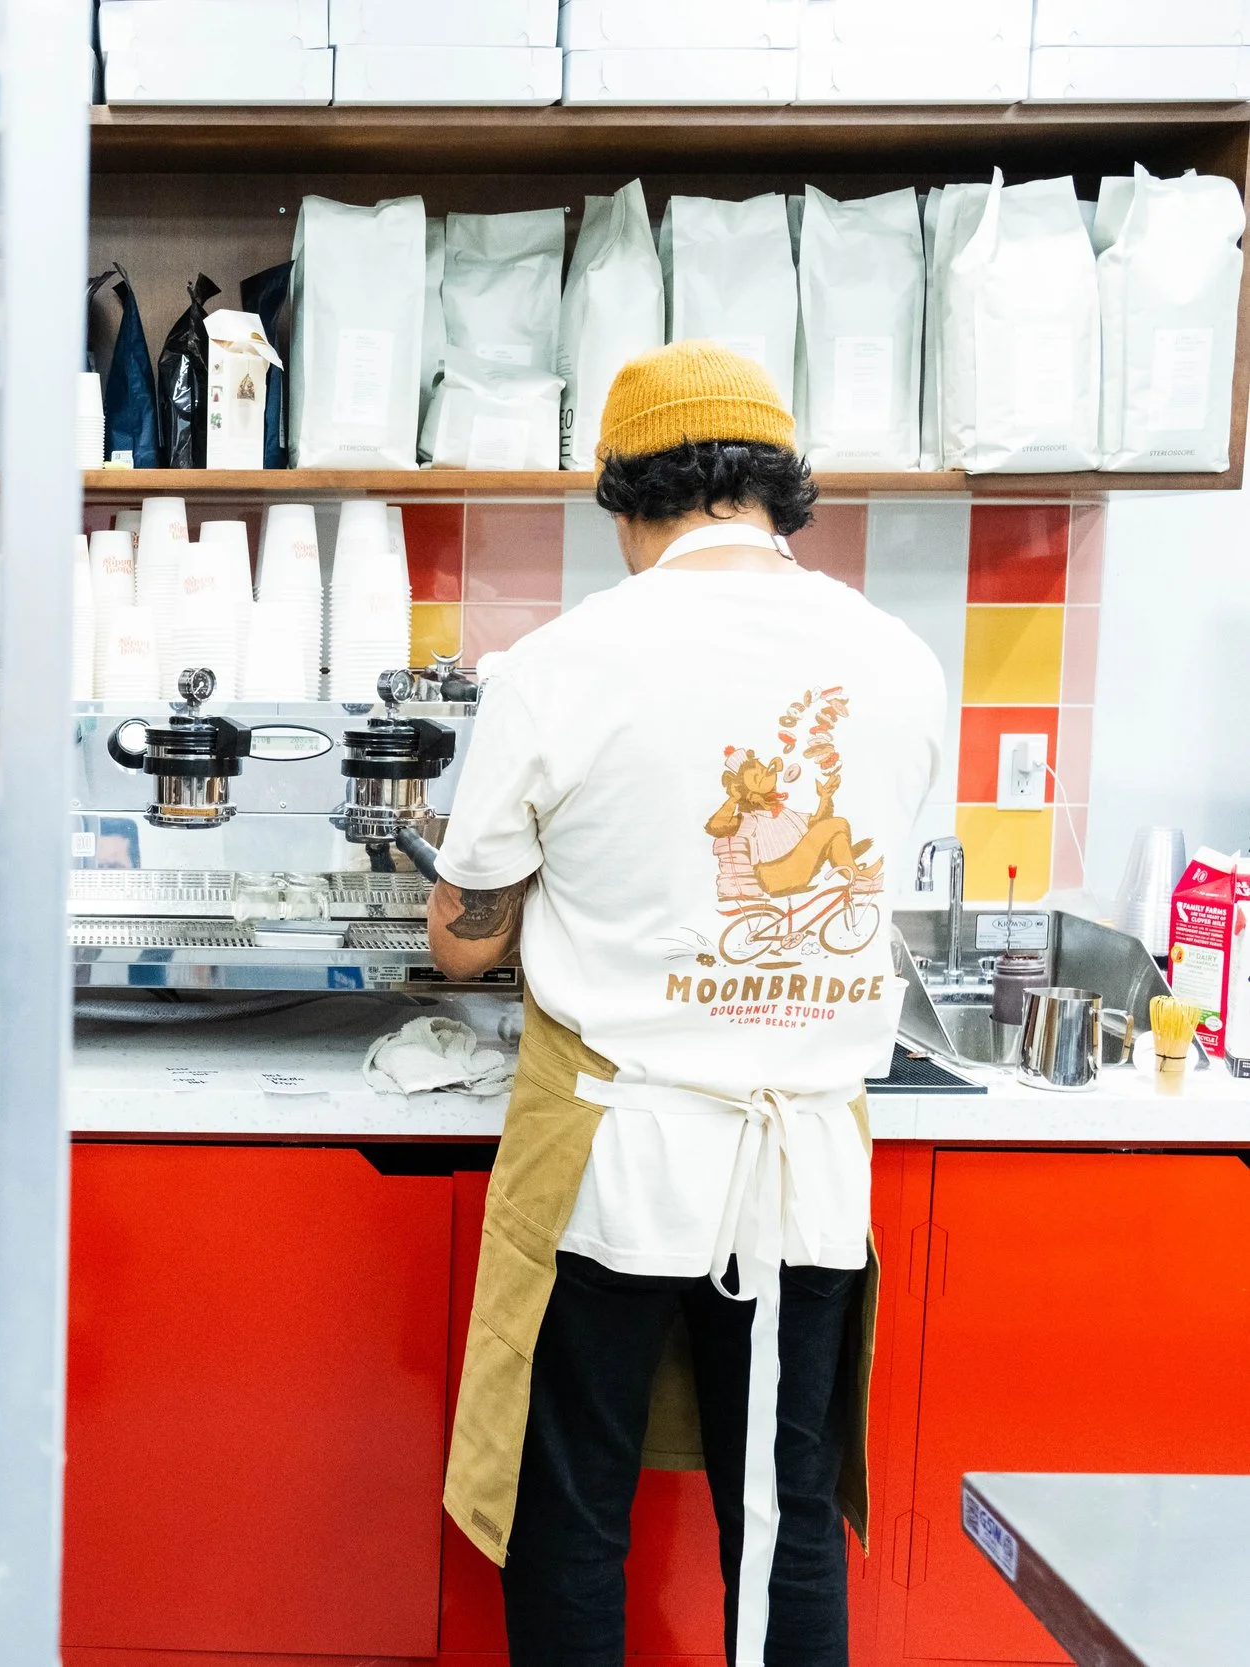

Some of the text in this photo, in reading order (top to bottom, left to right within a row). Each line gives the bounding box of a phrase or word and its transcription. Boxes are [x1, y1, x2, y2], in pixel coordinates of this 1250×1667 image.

[1149, 449, 1196, 457] STEREOSCOPE
[1183, 902, 1227, 916] FAMILY FARMS
[1191, 916, 1226, 927] CLOVER MILK
[1196, 953, 1217, 963] DAIRY
[666, 973, 885, 1004] MOONBRIDGE
[709, 1004, 836, 1020] DOUGHNUT STUDIO
[737, 1017, 797, 1029] LONG BEACH
